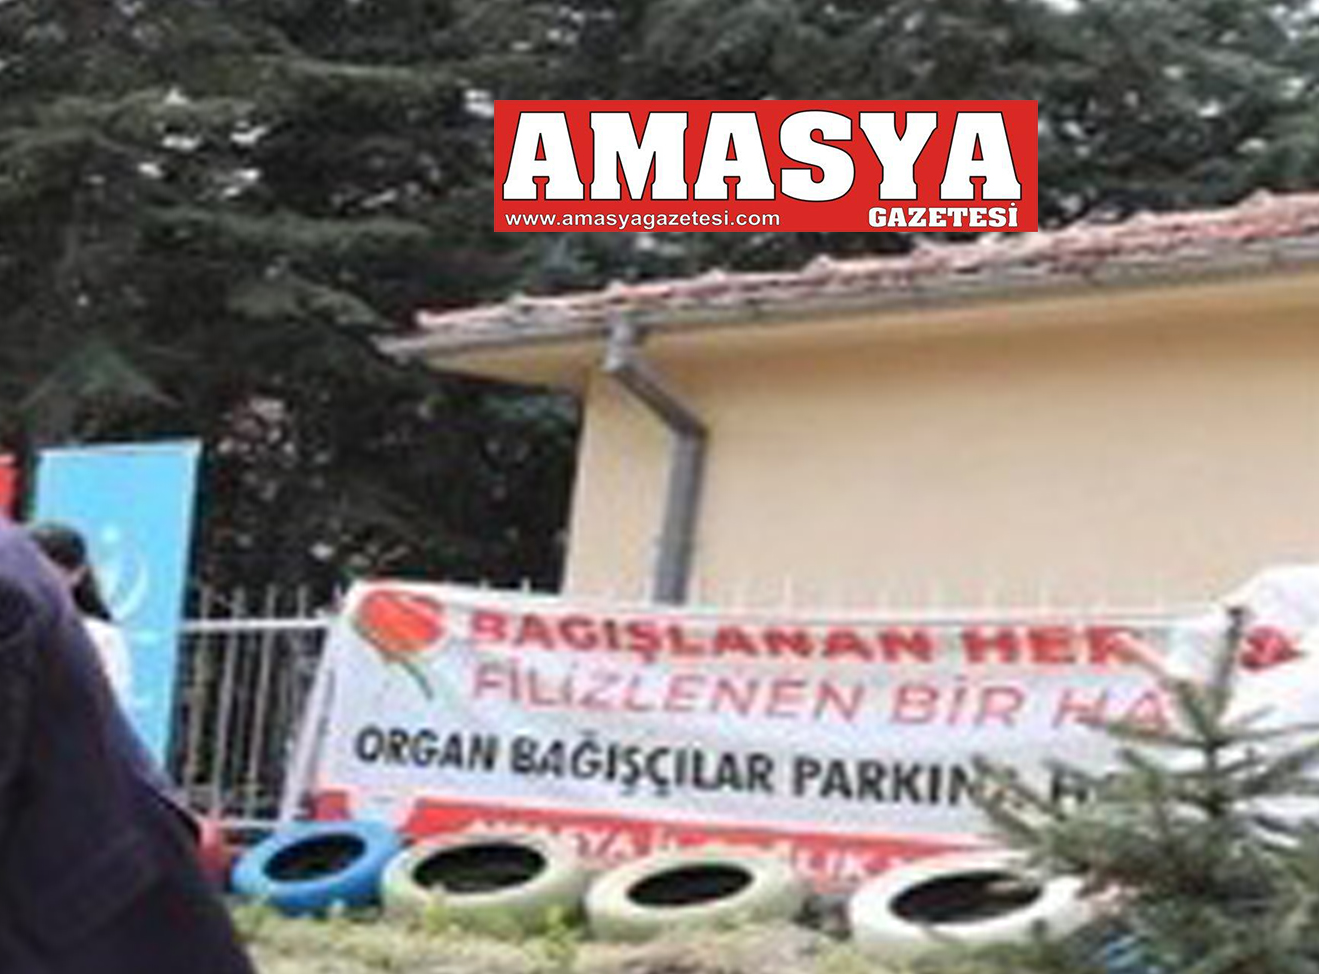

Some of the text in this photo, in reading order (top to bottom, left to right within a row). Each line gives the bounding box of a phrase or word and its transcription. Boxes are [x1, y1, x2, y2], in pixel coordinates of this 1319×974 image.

[890, 675, 1023, 727] BİR
[1050, 688, 1170, 733] HA
[354, 726, 500, 771] ORGAN
[509, 730, 775, 796] BAĞIŞÇILAR
[792, 756, 1034, 808] PARKIN
